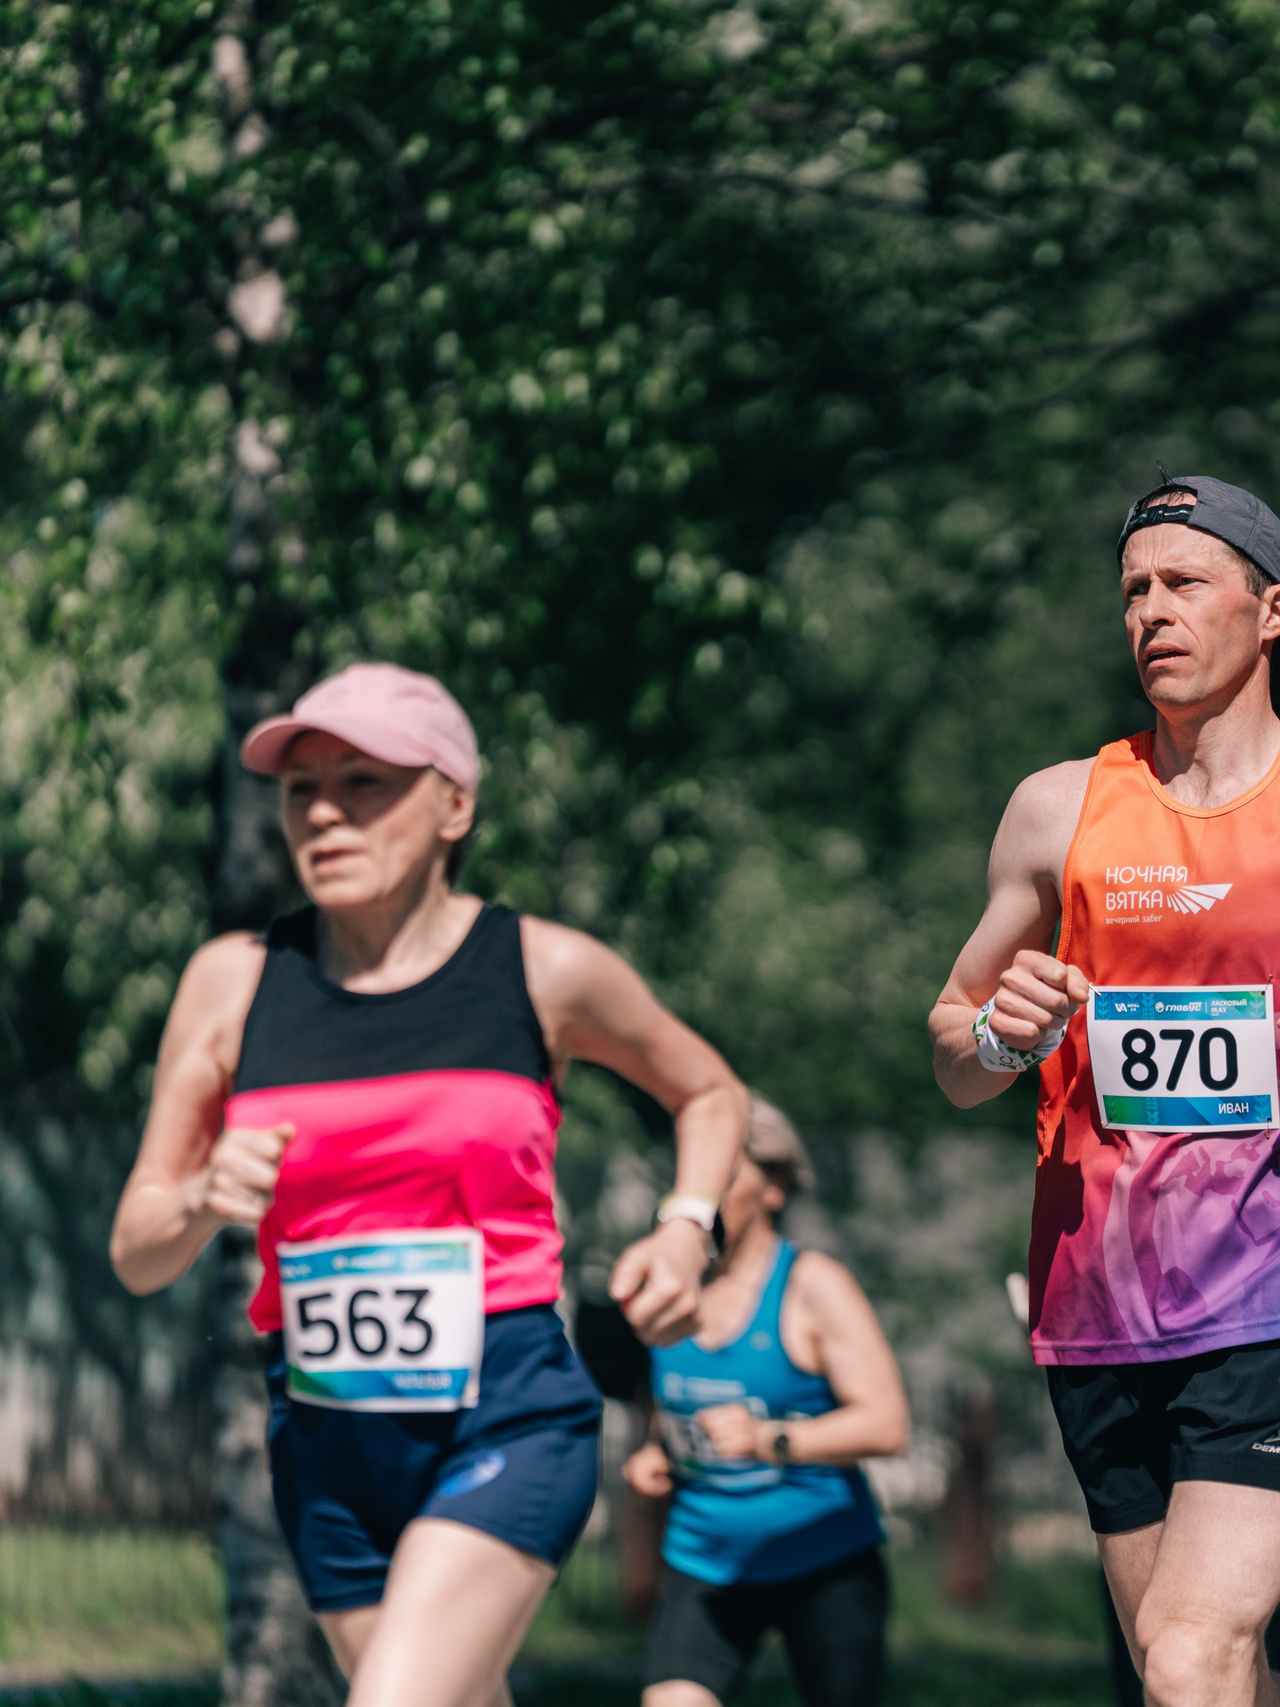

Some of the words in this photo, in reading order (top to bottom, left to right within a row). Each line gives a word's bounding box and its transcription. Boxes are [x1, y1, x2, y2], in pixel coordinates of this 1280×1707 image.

[1106, 866, 1188, 885] НОЧНАЯ
[1106, 890, 1163, 911] ВЯТКА
[1106, 915, 1140, 925] вечерний
[1142, 914, 1162, 923] забег
[1211, 999, 1247, 1007] ЛАСКОВЫЙ
[1121, 1027, 1239, 1092] 870
[1218, 1102, 1250, 1115] ИВАН
[297, 1288, 434, 1357] 563
